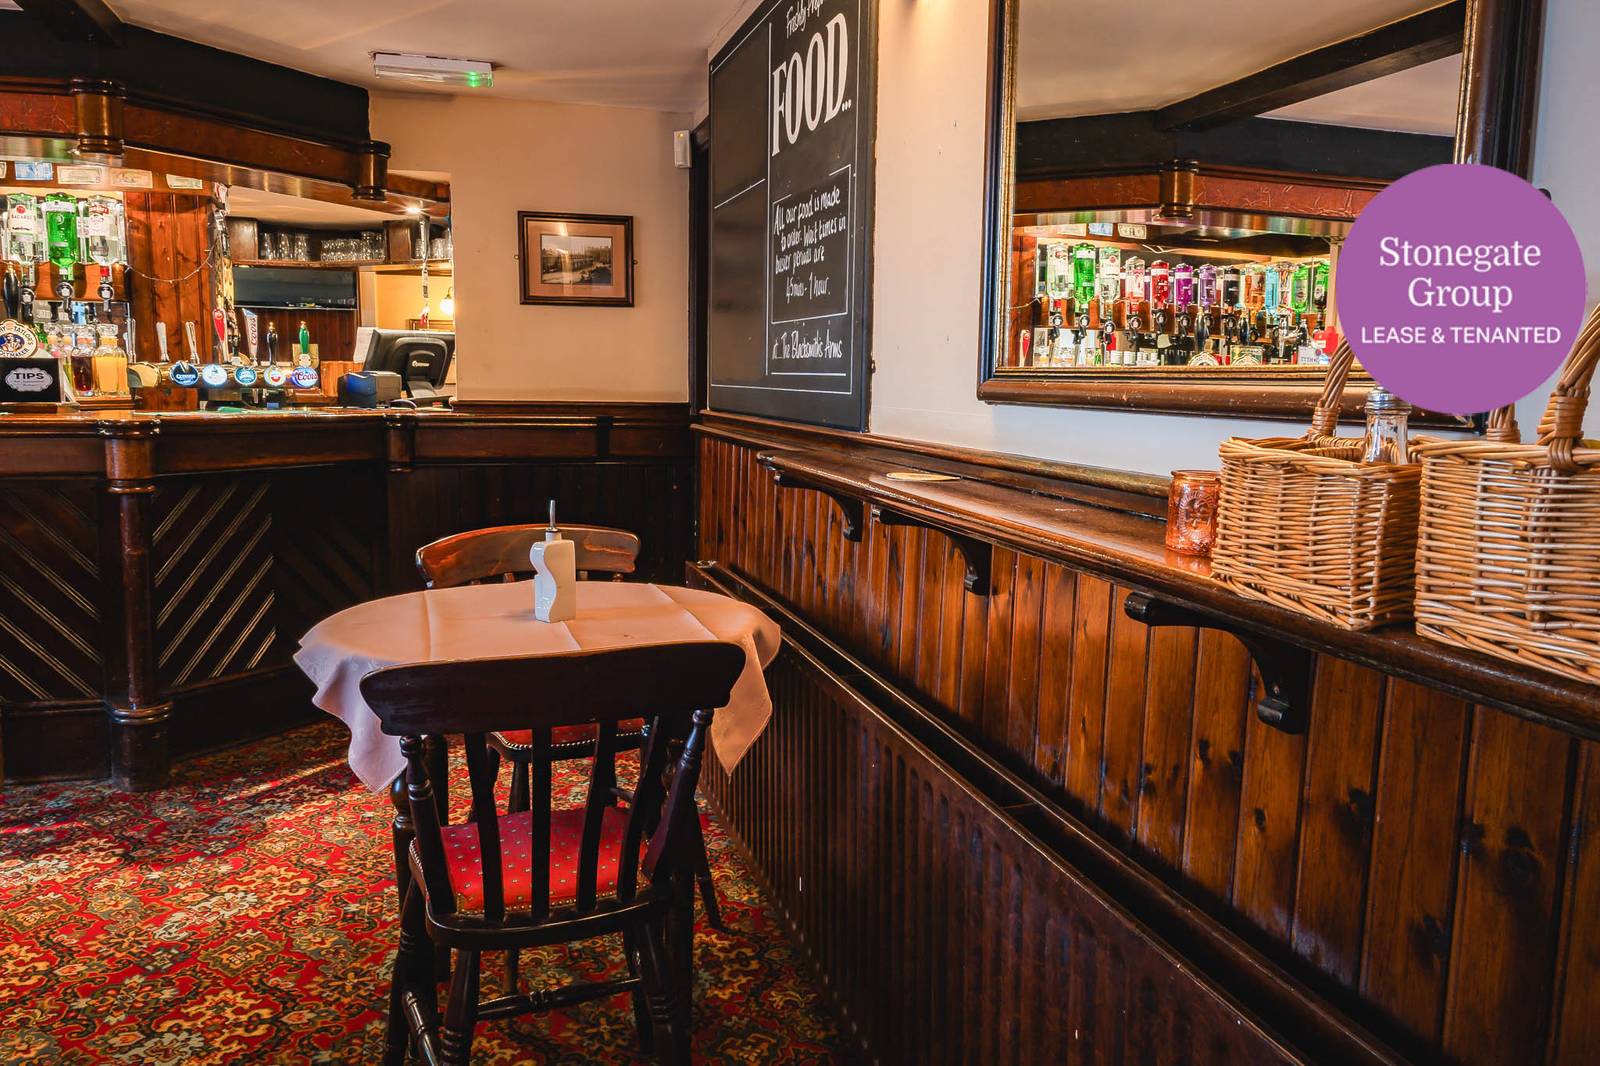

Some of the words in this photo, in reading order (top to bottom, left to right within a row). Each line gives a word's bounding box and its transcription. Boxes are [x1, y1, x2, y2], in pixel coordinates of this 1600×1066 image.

[774, 205, 785, 236] All
[786, 205, 798, 224] our
[798, 193, 814, 229] food
[814, 190, 820, 212] is
[820, 184, 841, 211] made
[819, 217, 837, 241] times
[838, 212, 846, 232] in
[813, 245, 825, 263] are
[824, 328, 843, 359] Arms
[13, 372, 44, 380] TIPS
